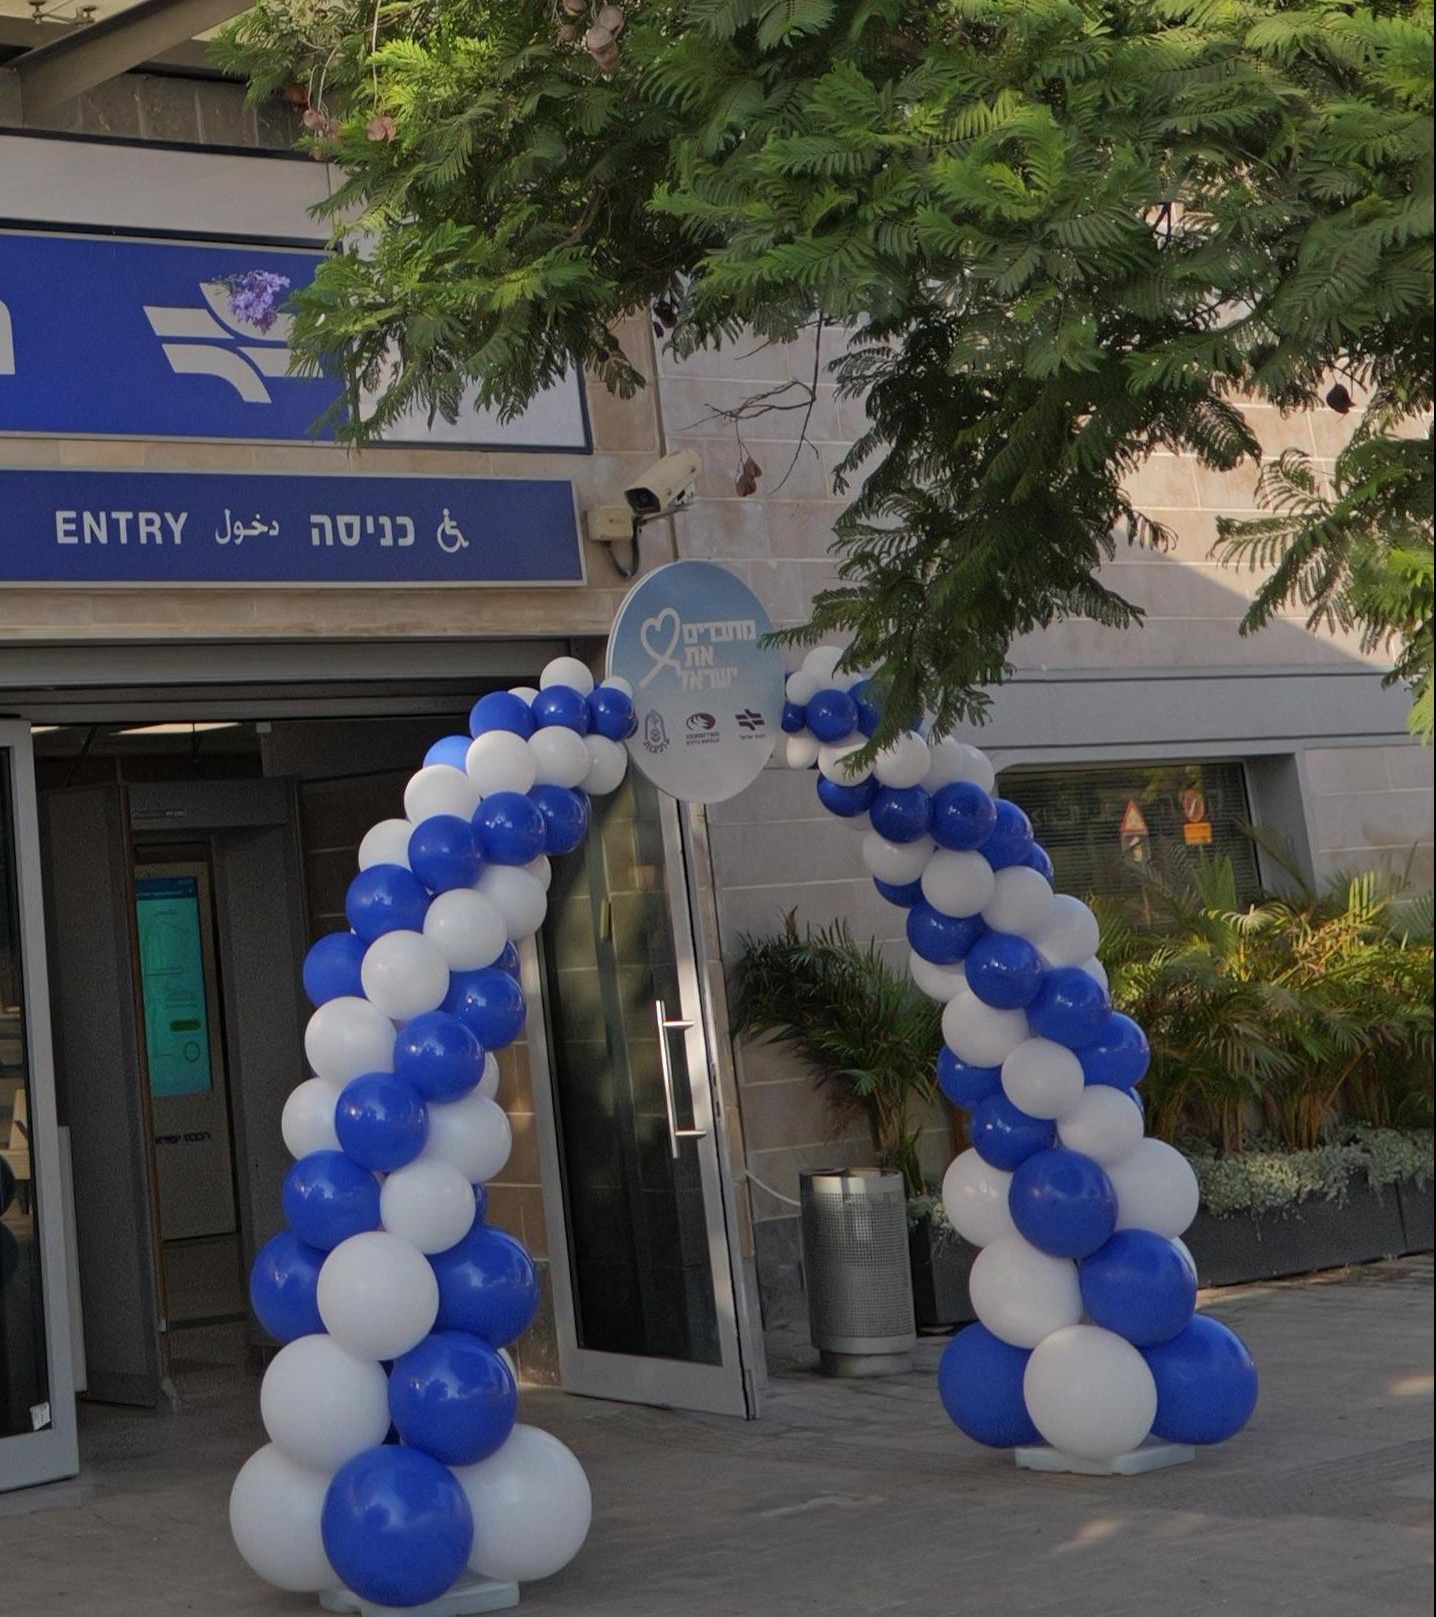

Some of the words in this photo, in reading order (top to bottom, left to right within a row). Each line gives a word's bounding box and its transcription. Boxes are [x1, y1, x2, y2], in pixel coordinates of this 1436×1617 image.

[55, 510, 189, 545] ENTRY
[214, 508, 280, 545] دخول
[309, 513, 416, 547] כניסה
[684, 646, 714, 667] את
